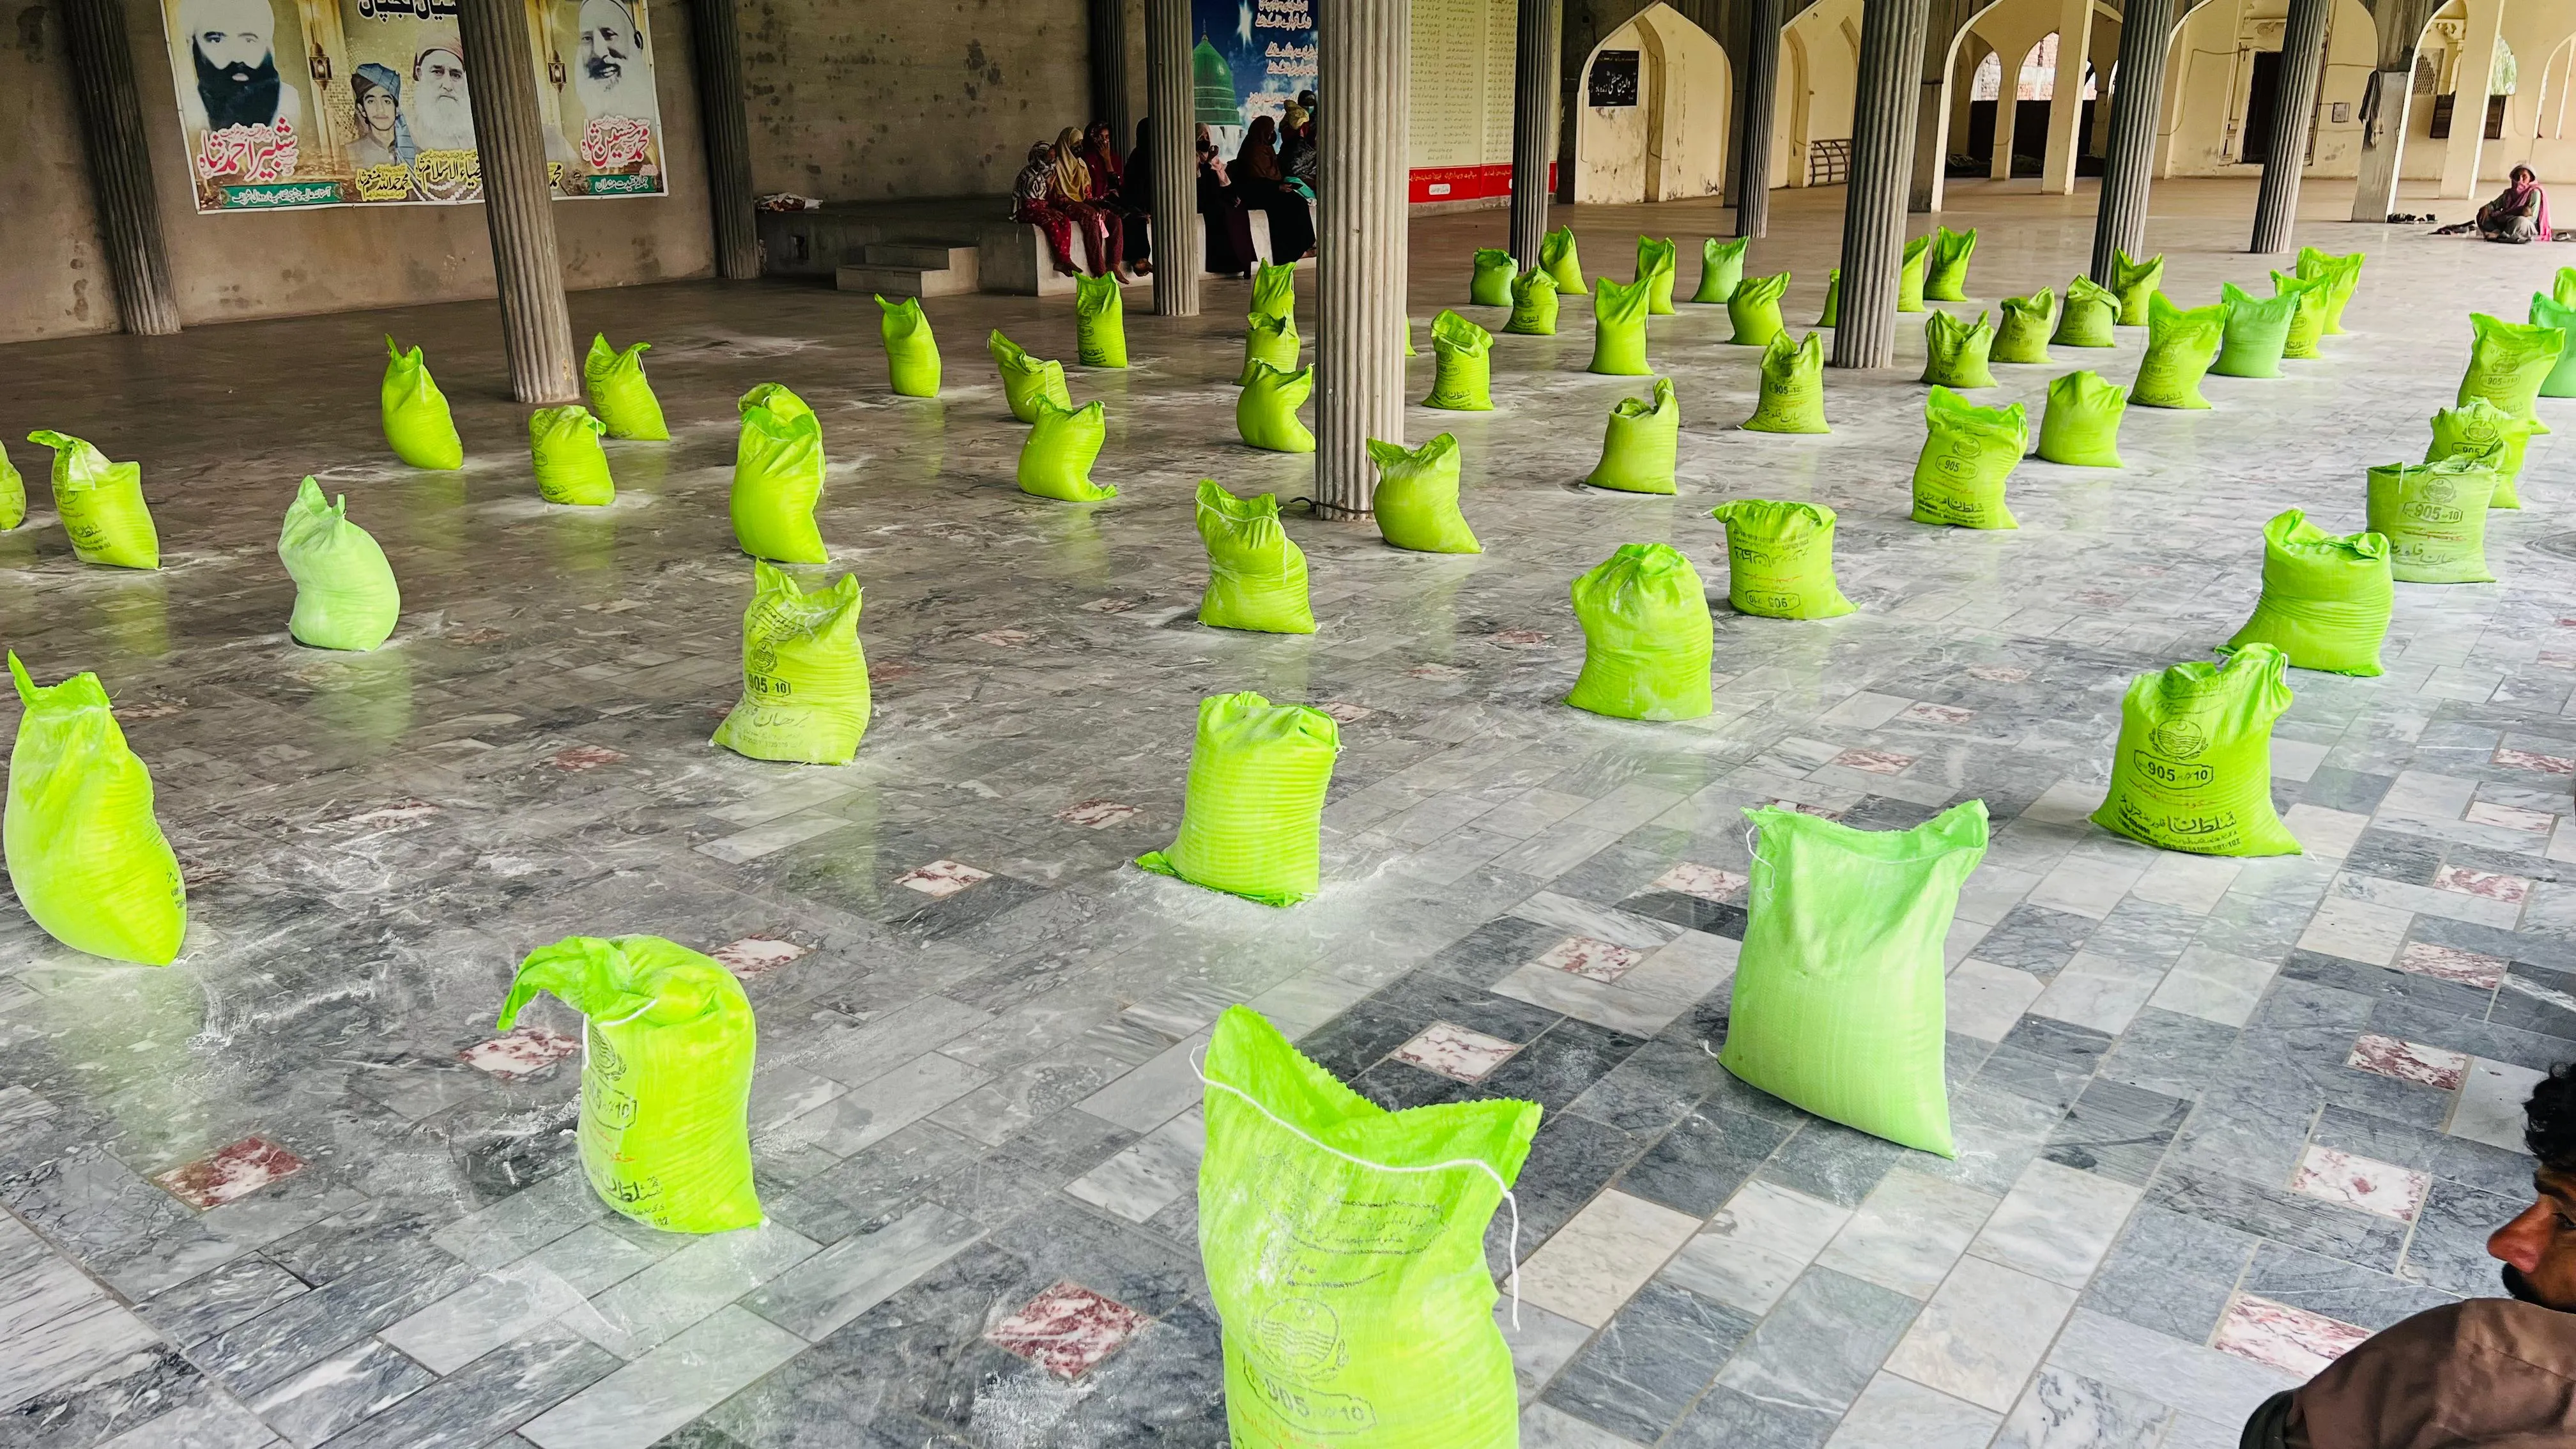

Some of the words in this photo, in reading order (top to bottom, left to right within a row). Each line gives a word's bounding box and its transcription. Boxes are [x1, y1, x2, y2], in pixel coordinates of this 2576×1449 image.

[1944, 459, 1959, 472] 905
[2414, 503, 2440, 521] 905
[748, 673, 769, 693] 905
[2147, 761, 2175, 782] 905
[2193, 770, 2208, 781] 10
[2166, 810, 2237, 835] سلطان
[1265, 1379, 1310, 1418] 905
